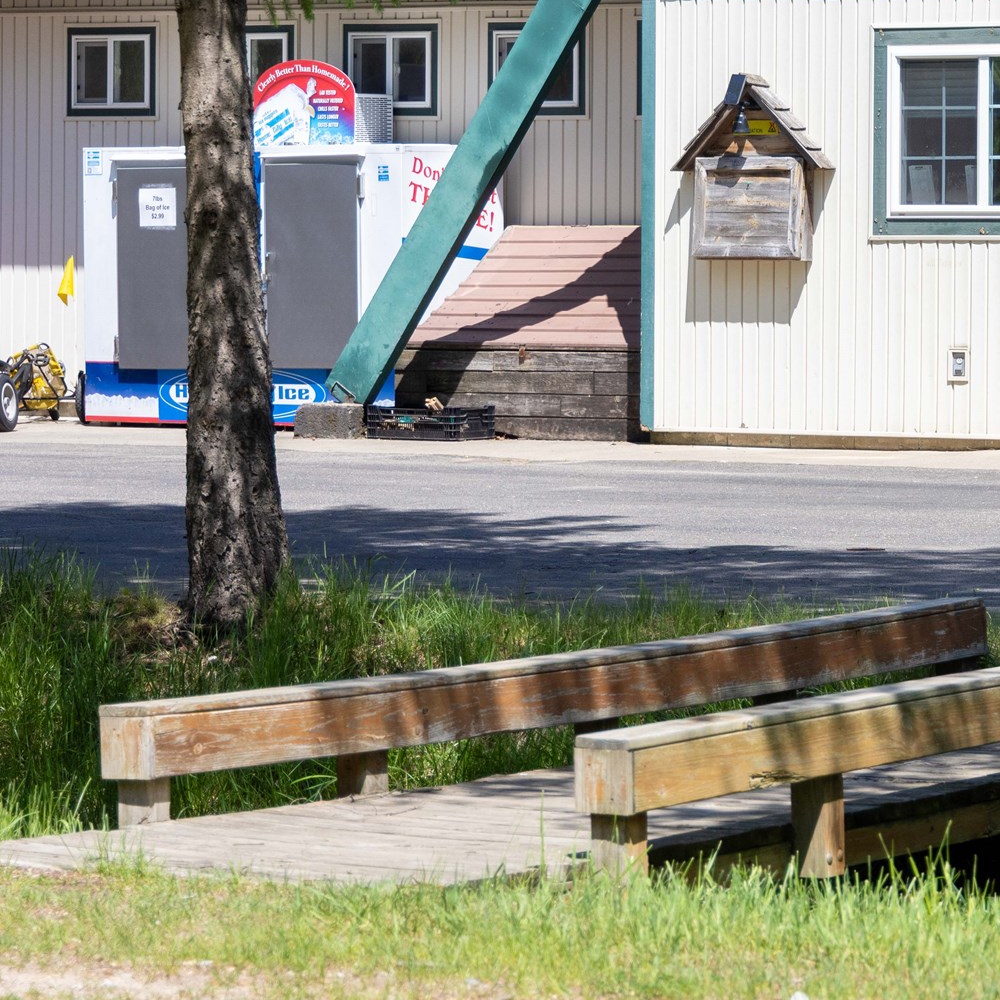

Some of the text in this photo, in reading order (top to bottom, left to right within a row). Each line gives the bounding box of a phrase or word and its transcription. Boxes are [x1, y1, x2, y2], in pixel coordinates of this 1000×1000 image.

[257, 73, 276, 92] Clearly
[275, 67, 295, 78] Better
[294, 64, 311, 73] Than
[145, 204, 156, 212] Bag
[278, 385, 310, 400] Ice
